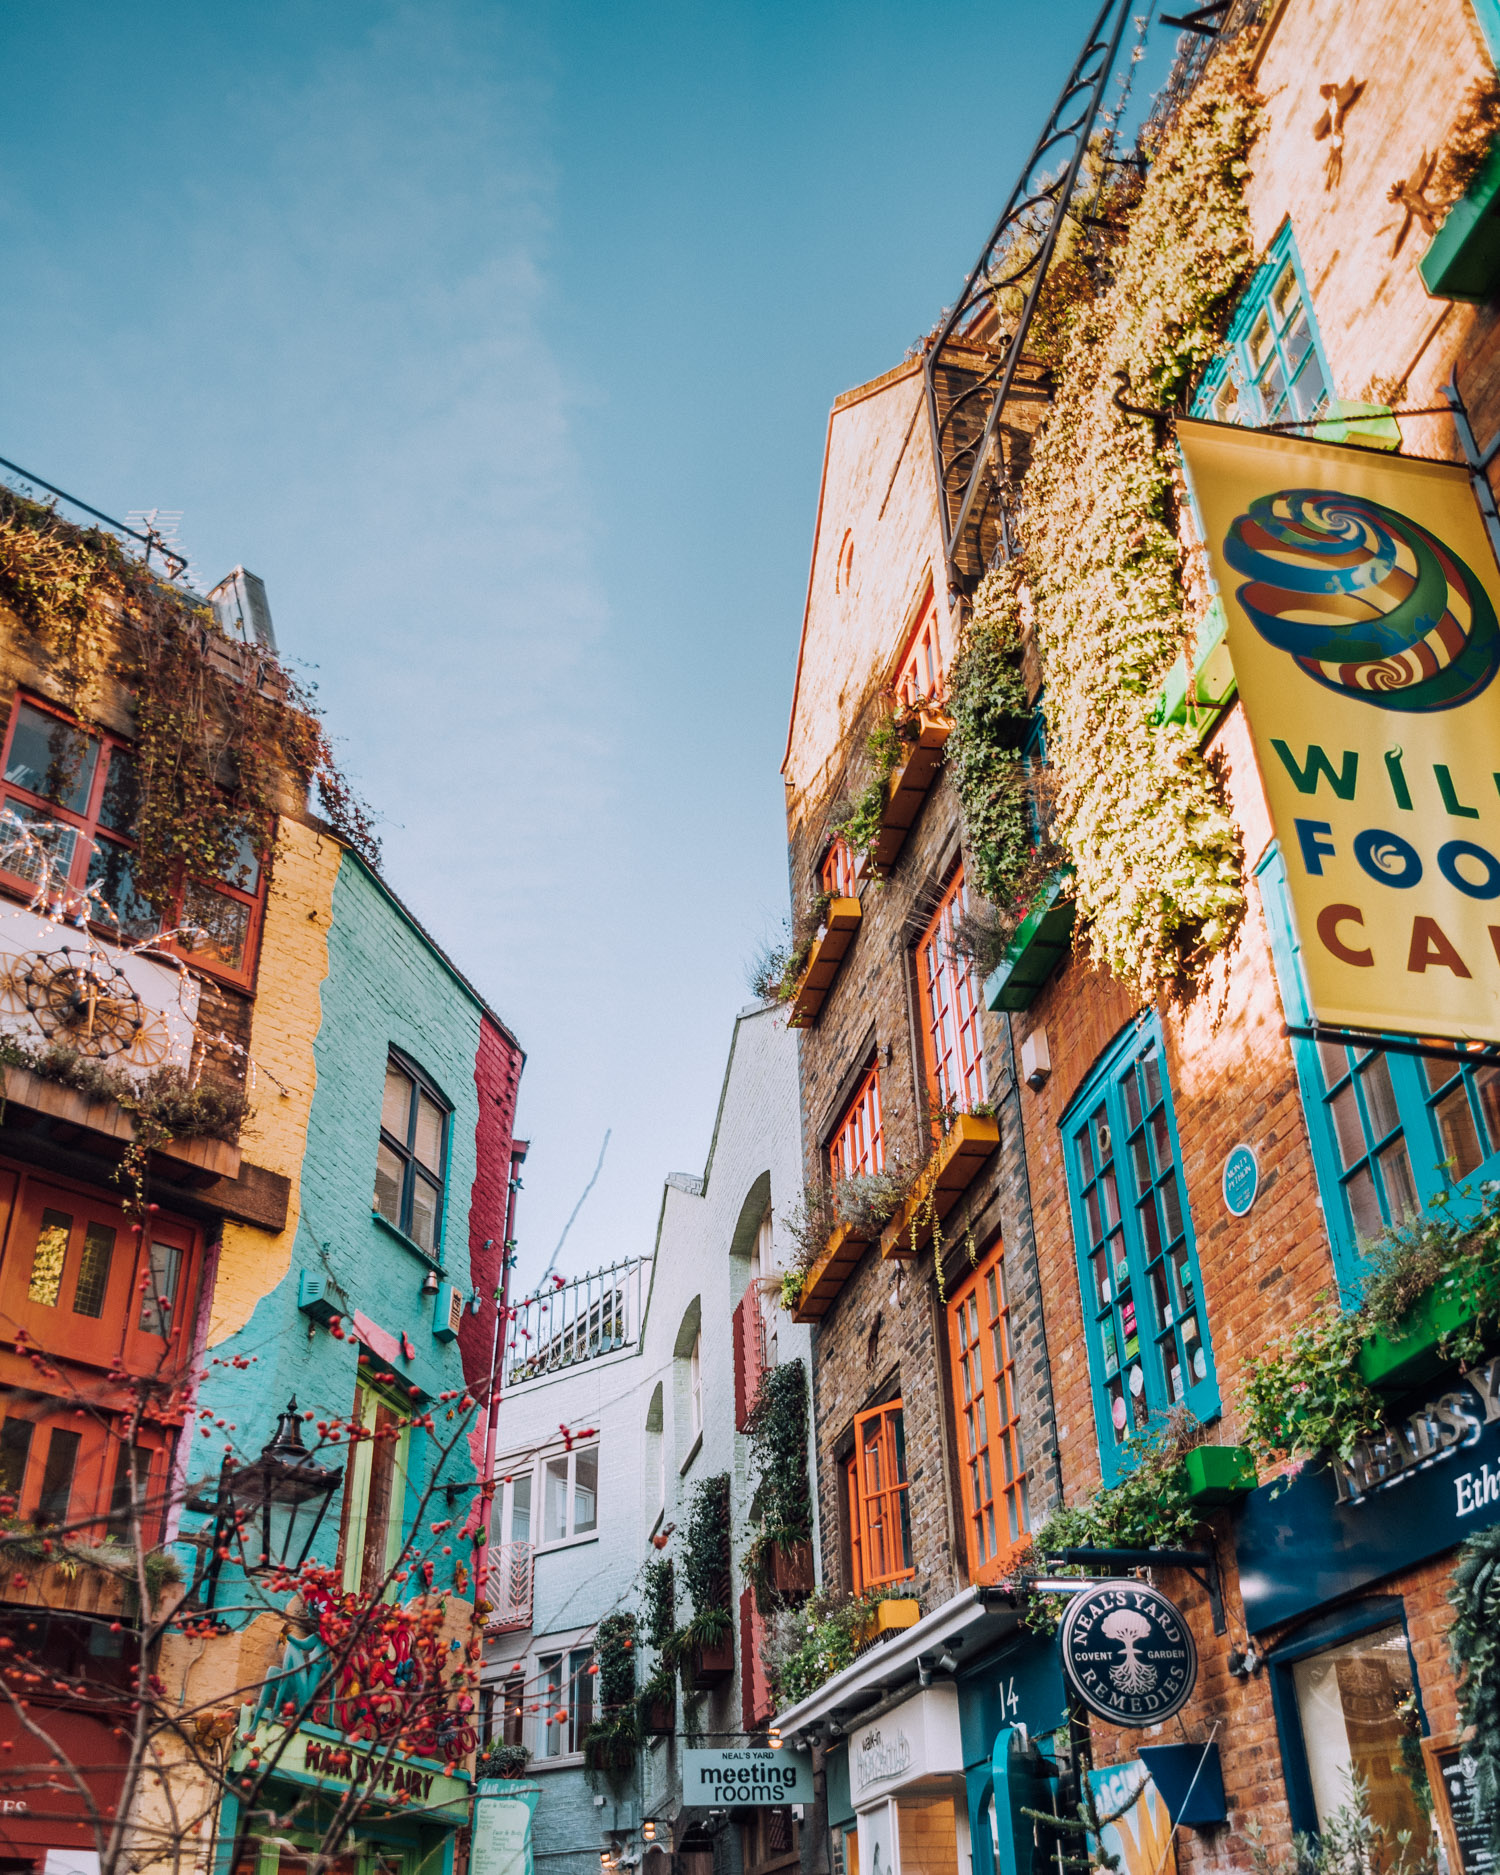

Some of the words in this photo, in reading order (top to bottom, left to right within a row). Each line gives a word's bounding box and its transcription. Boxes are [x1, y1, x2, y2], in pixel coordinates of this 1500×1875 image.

[1269, 738, 1500, 820] WIL
[1316, 903, 1500, 980] CA
[1227, 1156, 1247, 1179] MONTY
[1228, 1164, 1252, 1191] PYTHON
[1073, 1591, 1128, 1646] NEAL'S
[1133, 1592, 1180, 1643] YARD
[1074, 1651, 1113, 1662] COVENT
[1147, 1649, 1185, 1659] GARDEN
[999, 1676, 1019, 1721] 14
[1082, 1665, 1184, 1713] REMEDIES
[862, 1728, 882, 1752] walk-in
[722, 1752, 751, 1760] NEAL'S
[753, 1751, 775, 1760] YARD
[382, 1760, 434, 1800] FAIRY
[700, 1762, 797, 1788] meeting
[715, 1784, 785, 1802] rooms
